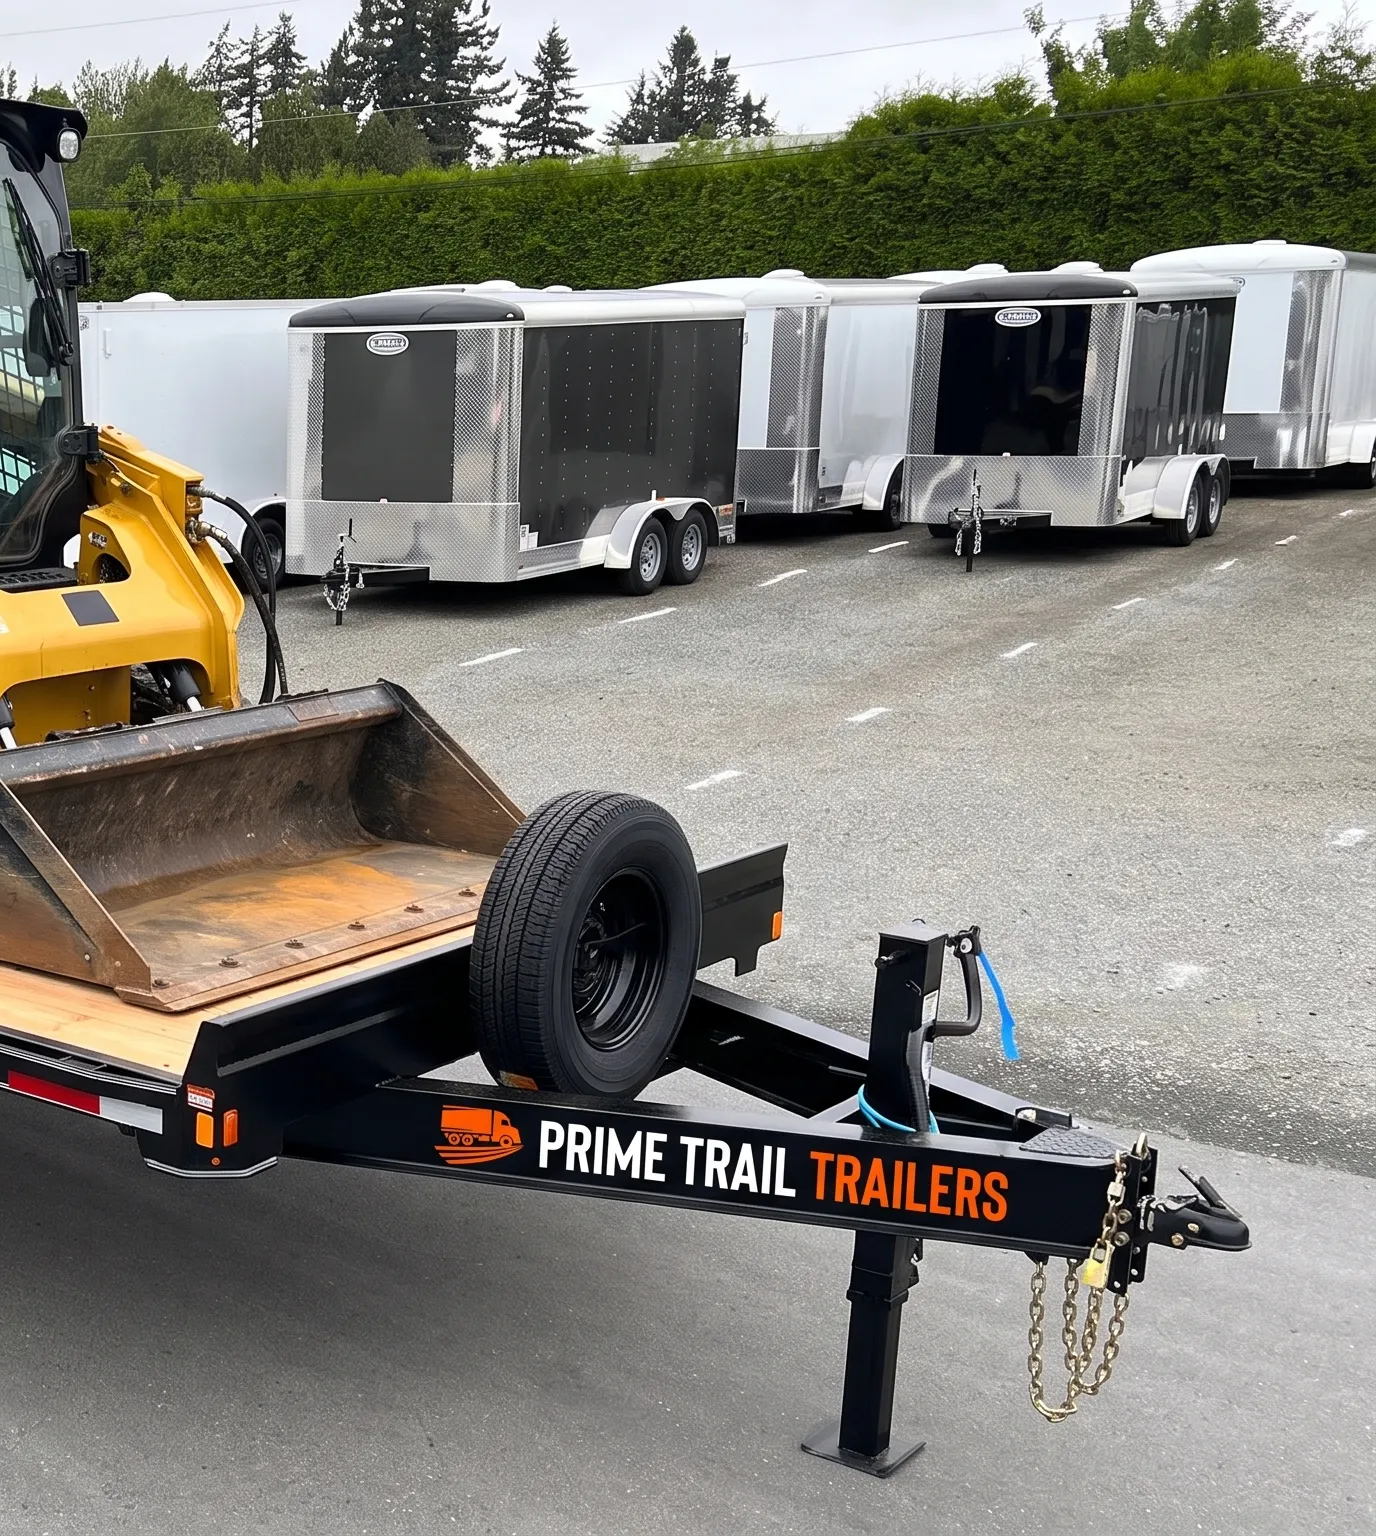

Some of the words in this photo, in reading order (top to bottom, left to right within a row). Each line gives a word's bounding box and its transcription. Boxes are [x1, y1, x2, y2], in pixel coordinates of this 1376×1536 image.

[539, 1120, 667, 1182] PRIME
[679, 1135, 796, 1198] TRAIL
[810, 1151, 1009, 1222] TRAILERS
